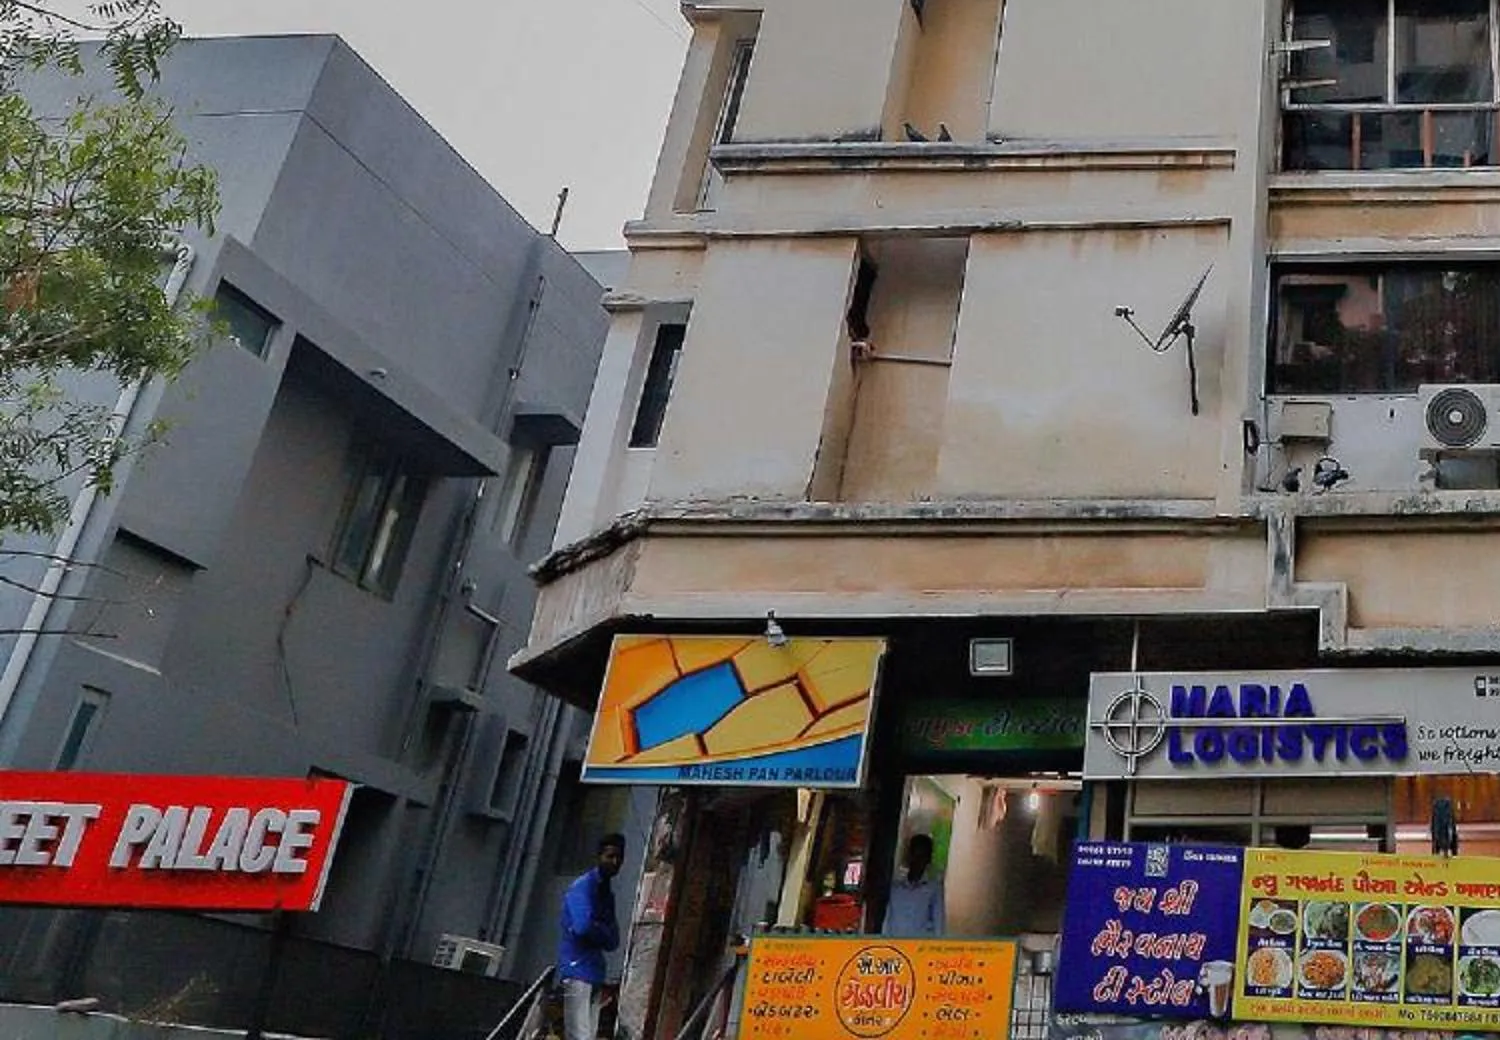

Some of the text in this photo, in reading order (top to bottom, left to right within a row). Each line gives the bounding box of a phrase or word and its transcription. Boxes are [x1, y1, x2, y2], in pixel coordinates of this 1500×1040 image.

[1171, 684, 1315, 718] MARIA
[1168, 724, 1409, 764] LOGISTICS
[678, 767, 858, 782] MAHESH PAN PARLOUR
[0, 801, 320, 873] EET PALACE
[1114, 886, 1156, 913] જય
